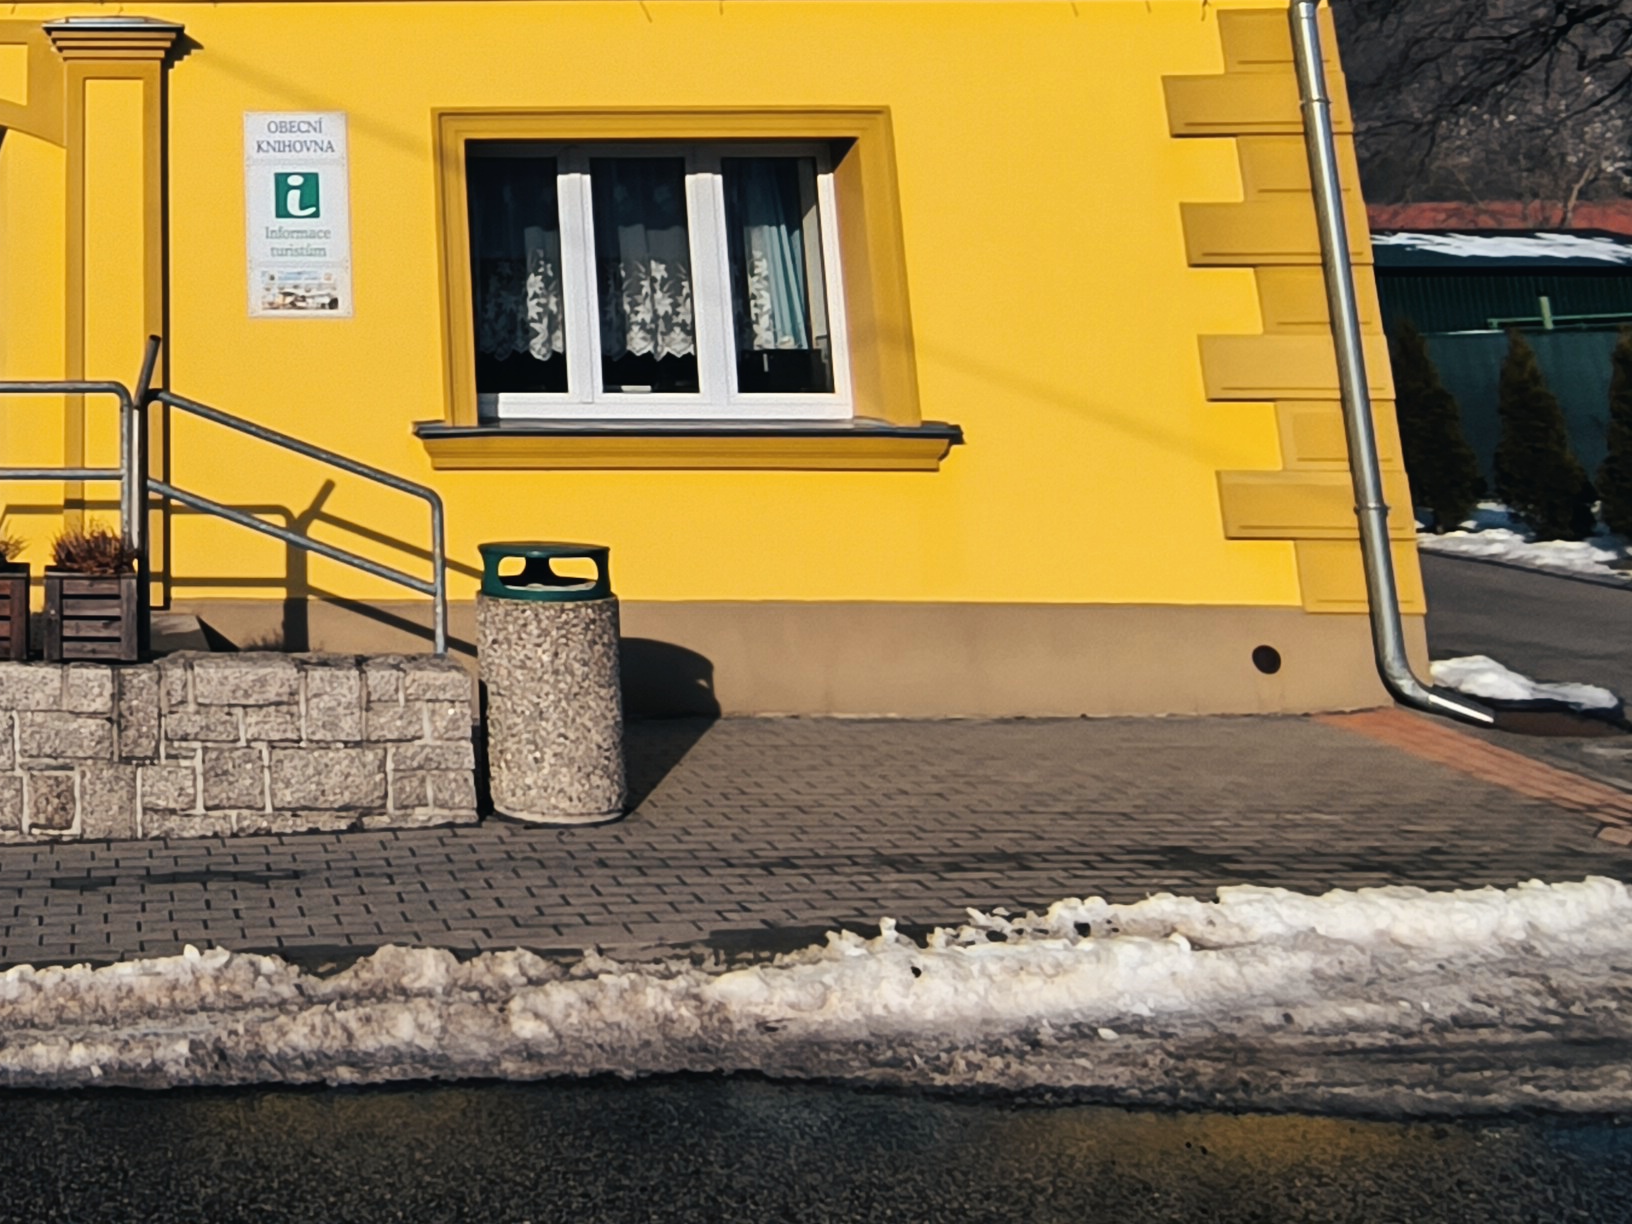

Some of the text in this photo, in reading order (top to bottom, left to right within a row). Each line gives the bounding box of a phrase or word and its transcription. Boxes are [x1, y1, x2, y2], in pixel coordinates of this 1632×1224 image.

[267, 117, 323, 134] OBECNÍ
[256, 139, 335, 154] KNIHOVNA
[265, 226, 332, 240] Informace
[270, 243, 327, 257] turistům
